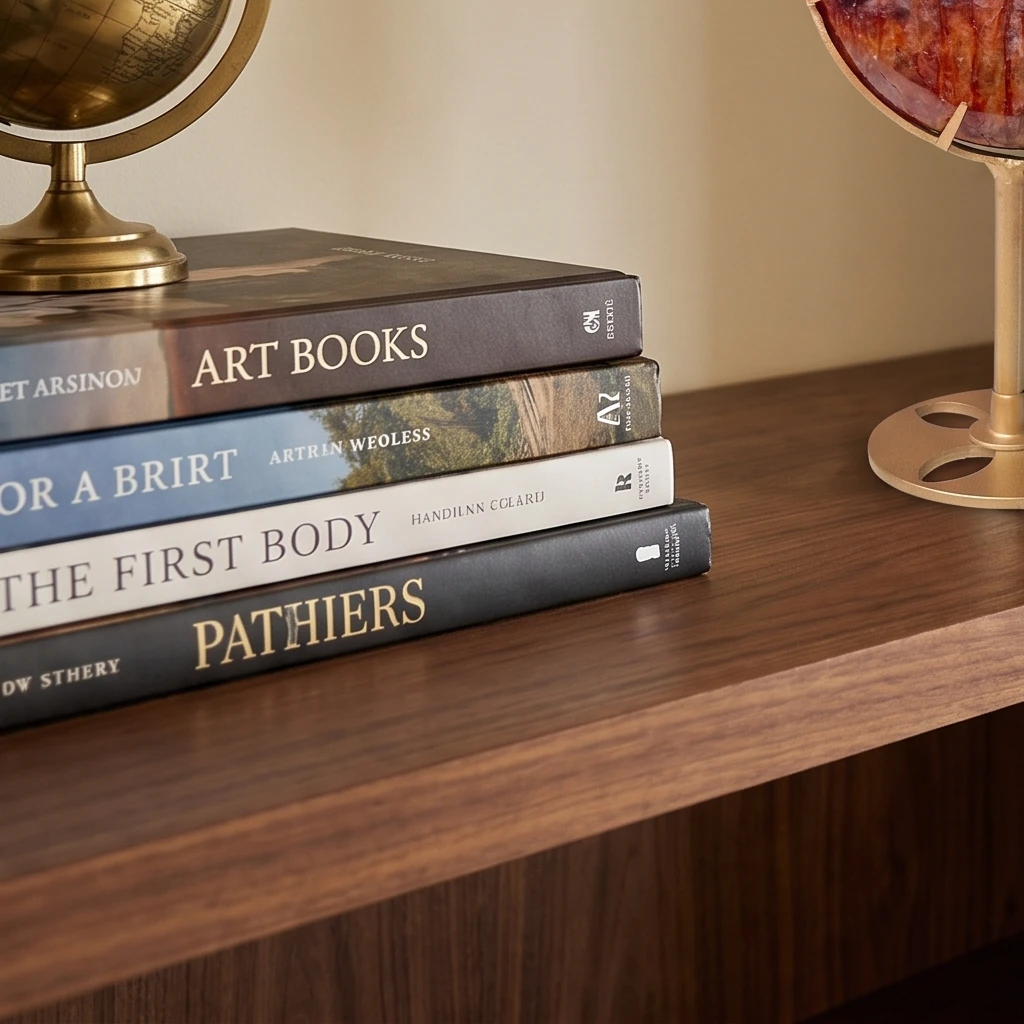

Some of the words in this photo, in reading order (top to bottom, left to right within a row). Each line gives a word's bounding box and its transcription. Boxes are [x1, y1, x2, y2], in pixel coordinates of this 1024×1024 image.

[191, 341, 279, 387] ART
[290, 324, 429, 374] BOOKS
[349, 427, 431, 452] WEOLESS
[71, 470, 101, 504] A
[113, 449, 238, 498] BRIRT
[0, 562, 94, 613] THE
[113, 535, 243, 593] FIRST
[261, 510, 380, 564] BODY
[193, 578, 426, 670] PATHIERS
[40, 658, 120, 689] STHERY
